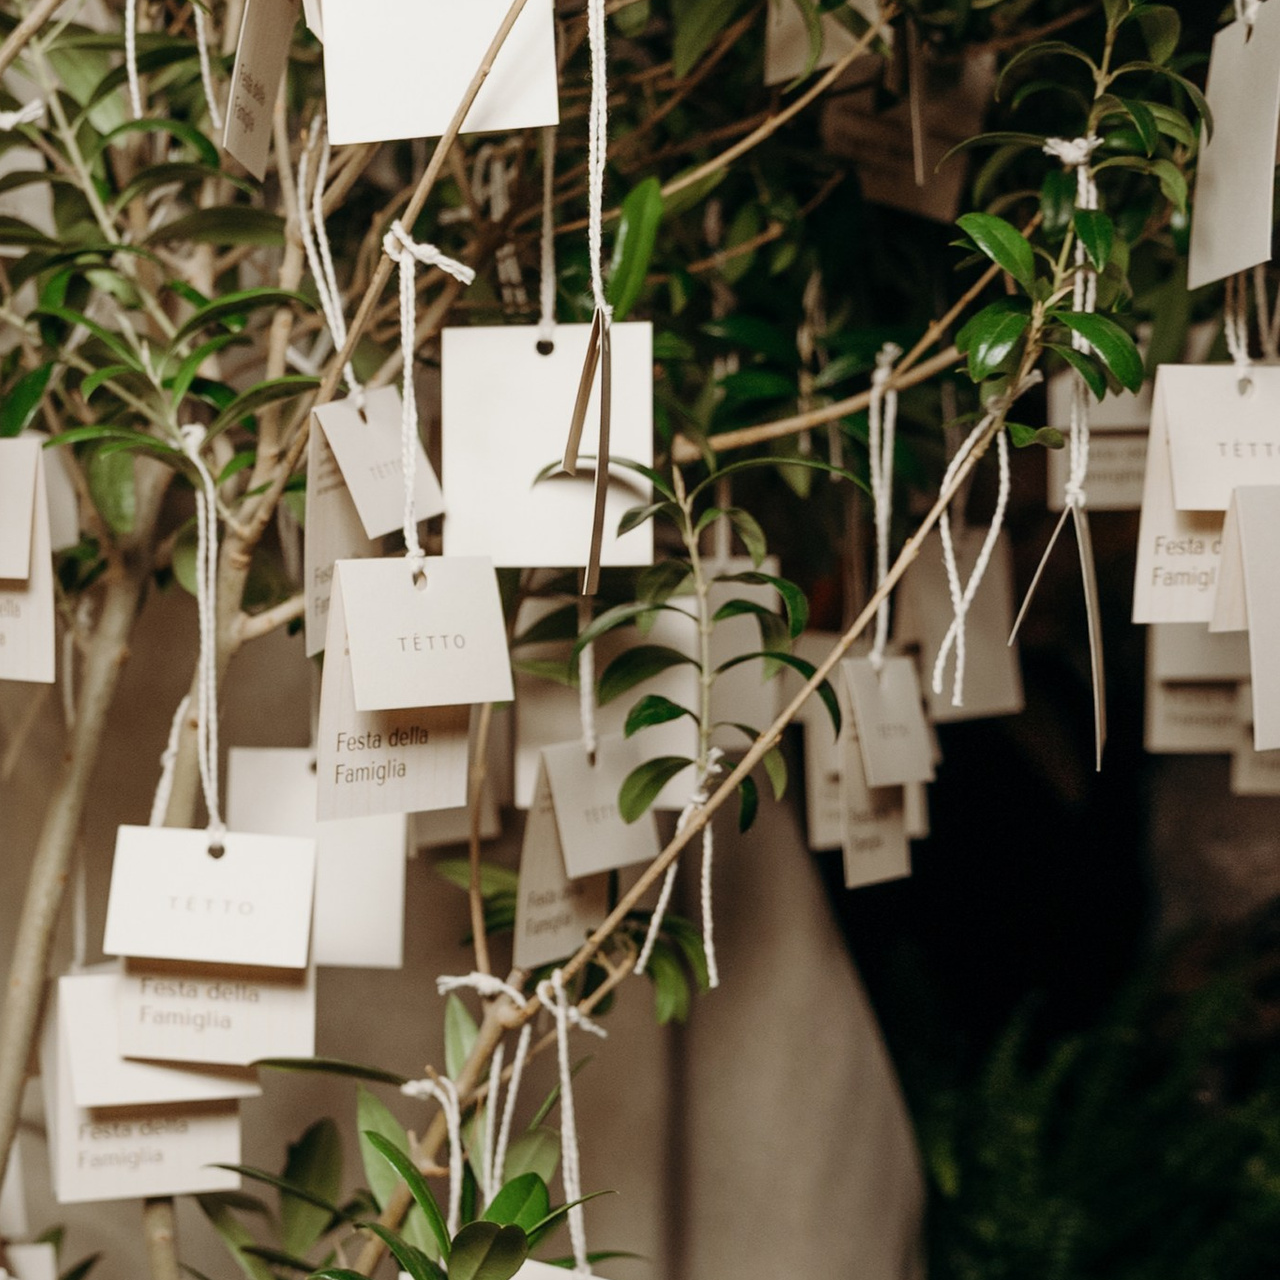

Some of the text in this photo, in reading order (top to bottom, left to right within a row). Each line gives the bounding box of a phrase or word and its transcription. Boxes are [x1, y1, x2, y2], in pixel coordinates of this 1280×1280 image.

[1153, 536, 1207, 556] Festa
[1152, 566, 1216, 592] Famigl
[397, 633, 466, 652] TÉTTO
[336, 726, 429, 752] Festa della
[335, 759, 406, 786] Famiglia
[139, 977, 261, 1004] Festa della
[139, 1005, 233, 1033] Famiglia
